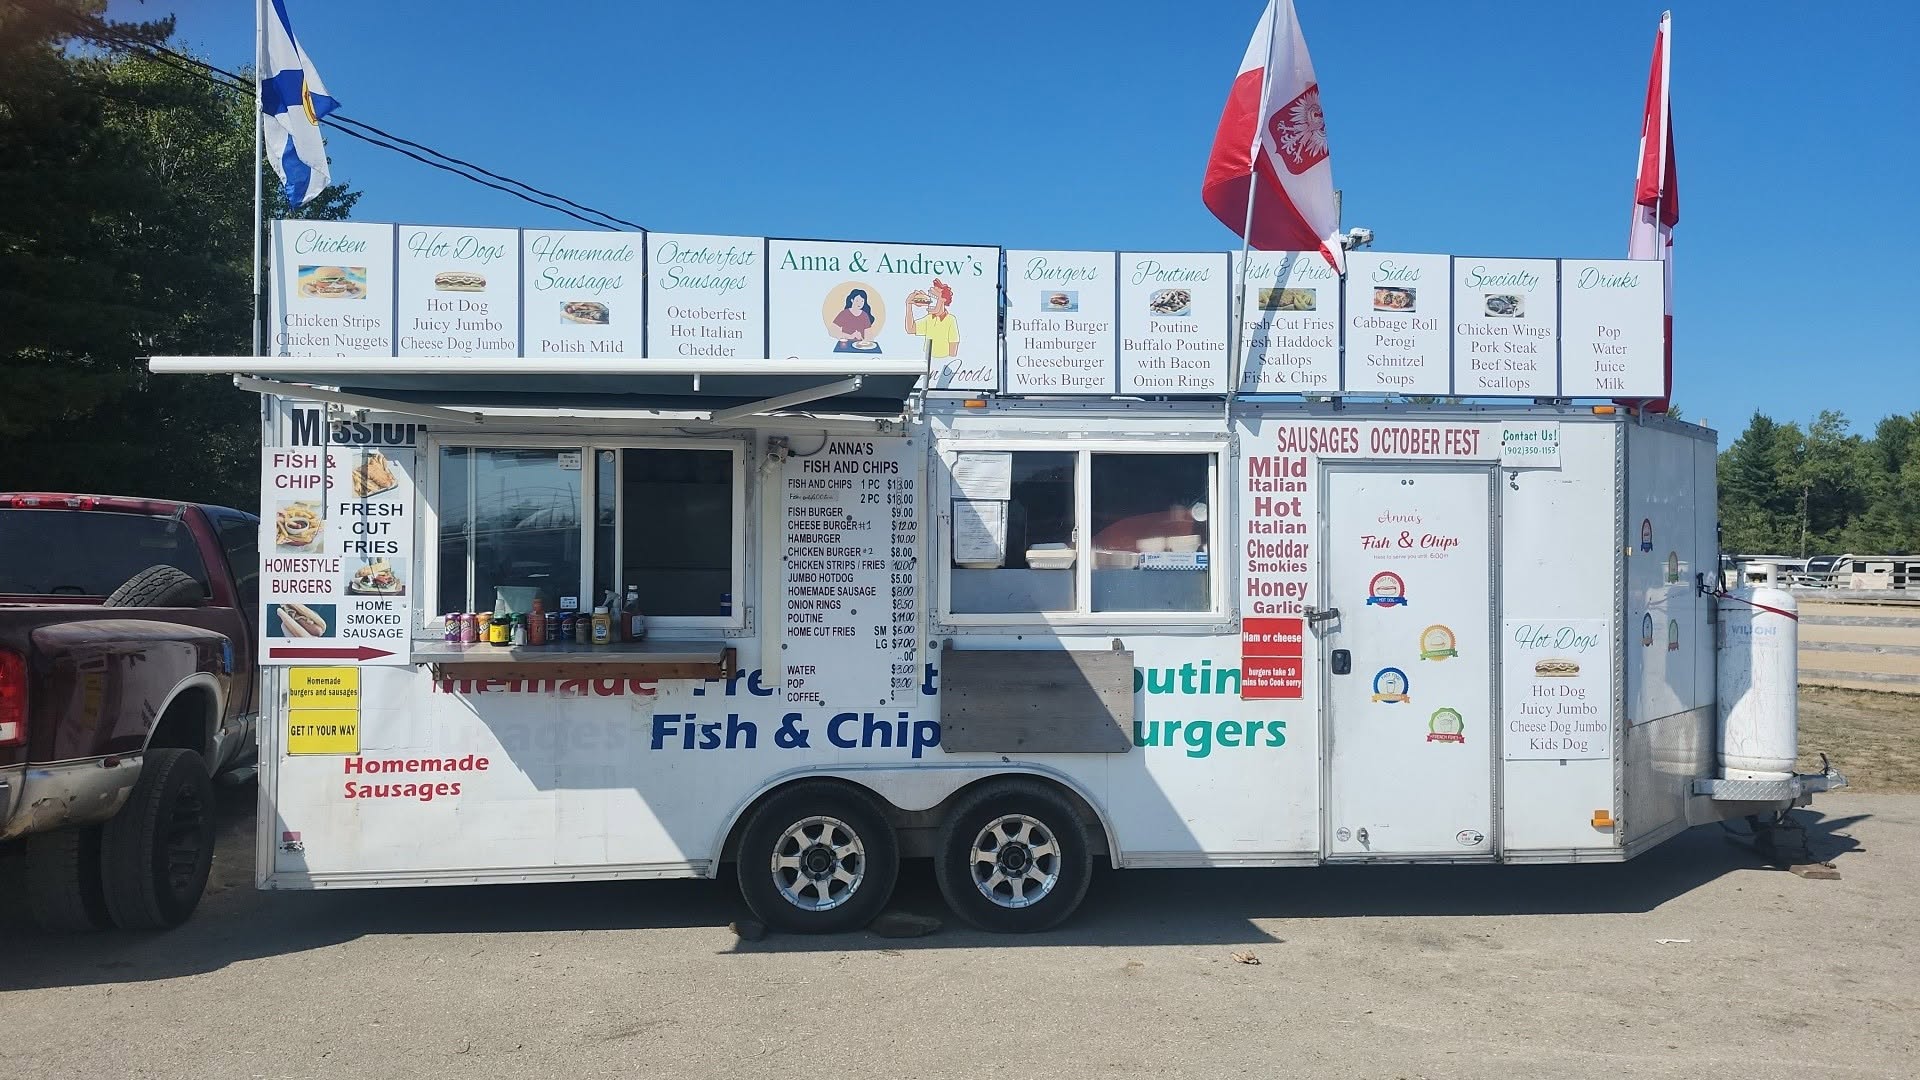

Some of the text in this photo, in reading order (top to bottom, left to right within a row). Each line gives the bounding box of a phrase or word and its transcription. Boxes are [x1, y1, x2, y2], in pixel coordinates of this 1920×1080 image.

[295, 230, 367, 255] Chicken
[408, 232, 506, 265] Hot Dogs
[532, 235, 634, 263] Homemade
[656, 241, 756, 271] Octoberfest
[780, 249, 983, 276] Anna & Andrew's
[1024, 257, 1098, 286] Burgers
[1132, 260, 1210, 285] Poutines
[1372, 260, 1421, 283] Sides
[1578, 266, 1640, 289] Drinks
[534, 266, 624, 294] Sausages
[660, 266, 747, 296] Sausages
[1465, 266, 1539, 292] Specialty
[427, 299, 488, 315] Hot Dog
[667, 306, 747, 321] Octoberfest
[284, 314, 381, 329] Chicken Strips
[413, 319, 503, 333] Juicy Jumbo
[1012, 319, 1108, 335] Buffalo Burger
[1150, 321, 1199, 333] Poutine
[1303, 319, 1334, 331] Fries
[1353, 317, 1438, 331] Cabbage Roll
[670, 324, 743, 339] Hot Italian
[1457, 324, 1551, 339] Chicken Wings
[1598, 326, 1621, 340] Pop
[276, 332, 389, 349] Chicken Nuggets
[541, 340, 624, 353] Polish Mild
[1024, 338, 1096, 352] Hamburger
[1124, 338, 1225, 352] Buffalo Poutine
[1276, 336, 1333, 349] Haddock
[1375, 335, 1416, 350] Perogi
[678, 343, 735, 357] Chedder
[1471, 342, 1537, 354] Pork Steak
[1592, 344, 1627, 355] Water
[1016, 356, 1104, 371] Cheeseburger
[1138, 357, 1210, 369] with Bacon
[1259, 354, 1312, 367] Scallops
[1367, 355, 1425, 367] Schnitzel
[1471, 359, 1537, 371] Beef Steak
[1594, 361, 1625, 372] Juice
[941, 359, 993, 385] Foods
[1290, 371, 1327, 385] Chips
[1016, 374, 1105, 389] Works Burger
[1134, 374, 1215, 390] Onion Rings
[1377, 373, 1414, 387] Soups
[1479, 377, 1530, 390] Scallops
[1596, 379, 1625, 390] Milk
[1277, 427, 1479, 456] SAUSAGES OCTOBER FEST
[1503, 430, 1557, 441] Contact Us!
[829, 442, 873, 455] ANNA'S
[274, 454, 317, 468] FISH
[804, 460, 898, 474] FISH AND CHIPS
[1249, 457, 1307, 477] Mild
[275, 475, 333, 489] CHIPS
[788, 479, 880, 489] FISH AND CHIPS PC
[1249, 479, 1307, 492] Italian
[868, 494, 879, 504] PC
[340, 503, 403, 516] FRESH
[788, 507, 913, 518] FISH BURGER $9.00
[1255, 497, 1301, 517] Hot
[1378, 509, 1422, 524] Anna's
[352, 522, 390, 535] CUT
[788, 521, 857, 530] CHEESE BURGER
[1249, 520, 1307, 534] Italian
[788, 534, 840, 543] HAMBURGER
[1361, 531, 1460, 551] Fish & Chips
[344, 541, 399, 553] FRIES
[788, 547, 912, 557] CHICKEN BURGER $8.00
[1247, 539, 1308, 558] Cheddar
[265, 559, 339, 573] HOMESTYLE
[788, 560, 885, 570] CHICKEN STRIPS FRIES
[1248, 560, 1307, 572] Smokies
[788, 573, 912, 584] JUMBO HOTDOG $5.00
[272, 580, 332, 593] BURGERS
[788, 587, 876, 596] HOMEMADE SAUSAGE
[1247, 578, 1308, 601] Honey
[356, 601, 392, 611] HOME
[788, 600, 841, 609] ONION RINGS
[1254, 601, 1302, 614] Garlic
[347, 615, 400, 625] SMOKED
[788, 614, 823, 623] POUTINE
[343, 629, 403, 638] SAUSAGE
[788, 627, 856, 636] HOME CUT FRIES
[1243, 632, 1301, 642] Ham cheese
[1515, 624, 1599, 653] Hot Dogs
[788, 666, 816, 675] WATER
[307, 677, 341, 685] Homemade
[788, 679, 804, 688] POP
[290, 688, 358, 697] burgers and sausages
[788, 693, 820, 702] COFFEE
[1533, 685, 1585, 699] Hot Dog
[1520, 703, 1597, 717] Juicy Jumbo
[291, 726, 355, 736] GET IT YOUR WAY
[650, 714, 758, 750] Fish
[773, 712, 811, 749] &
[344, 755, 489, 774] Homemade
[344, 781, 461, 802] Sausages
